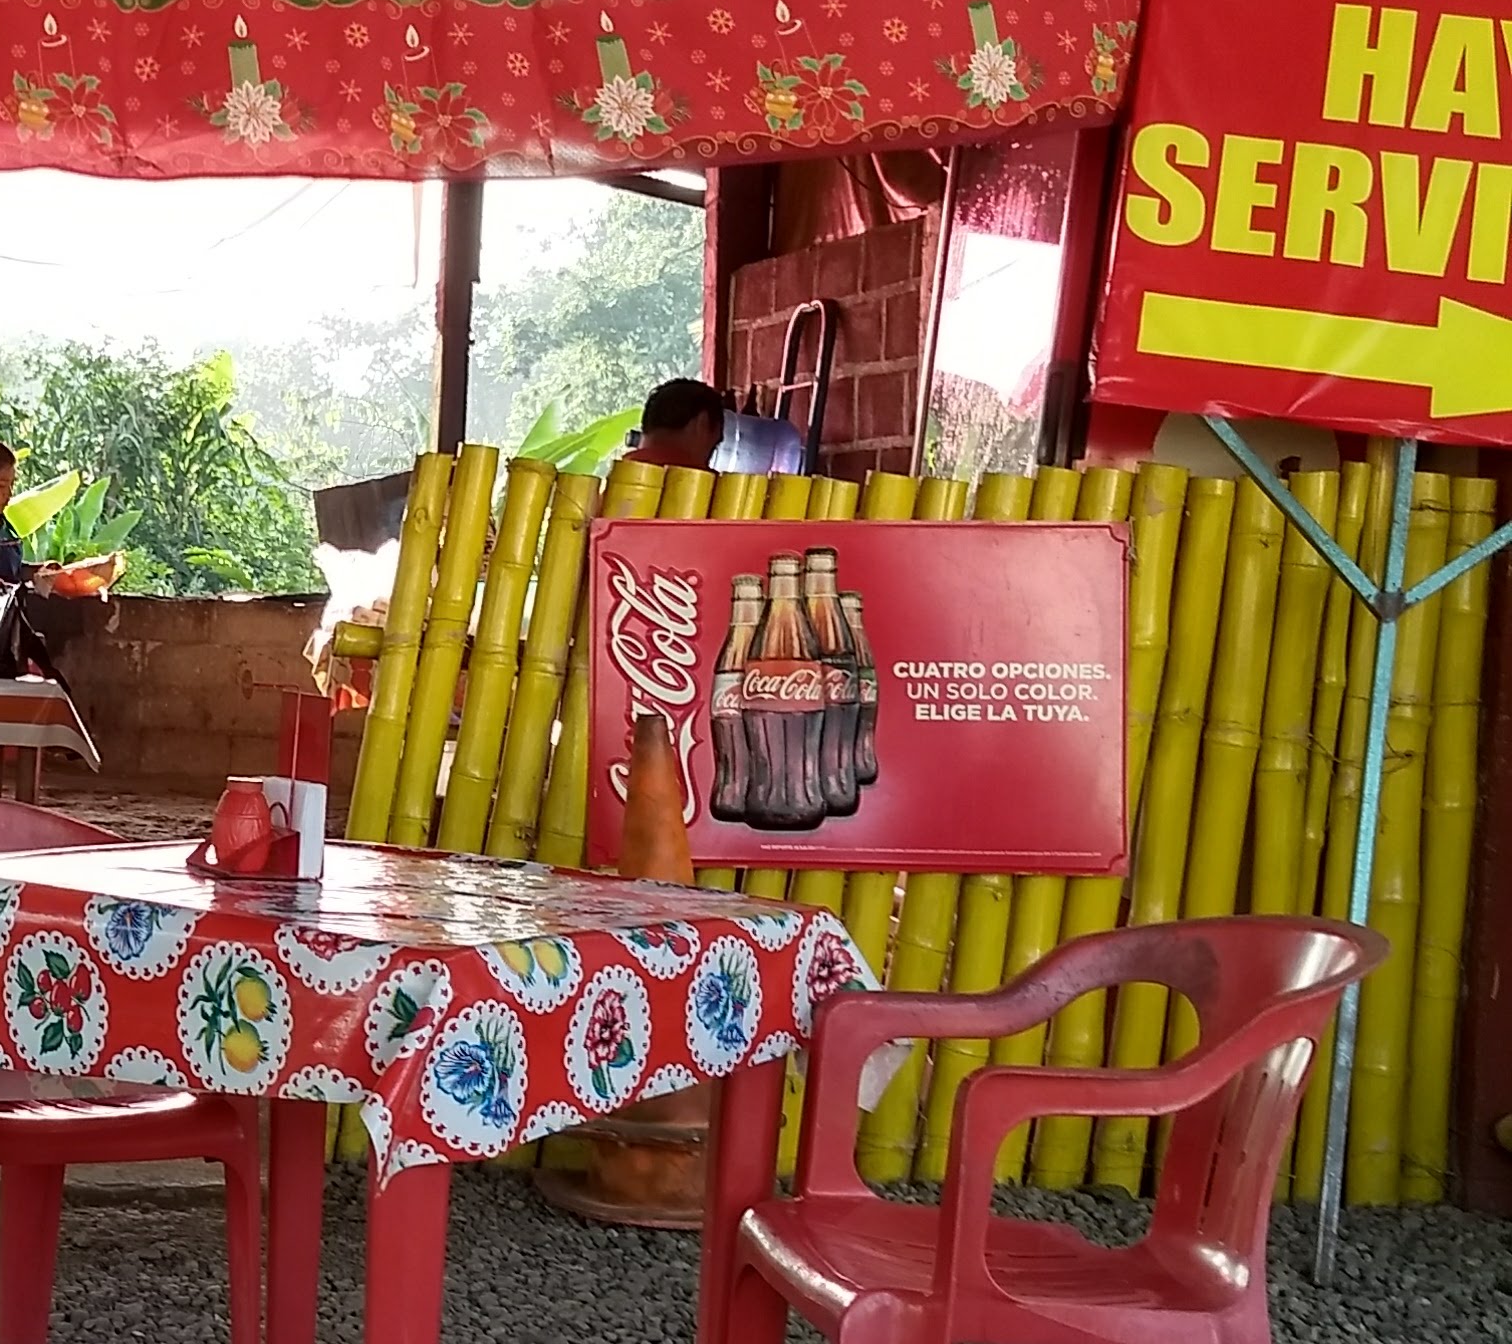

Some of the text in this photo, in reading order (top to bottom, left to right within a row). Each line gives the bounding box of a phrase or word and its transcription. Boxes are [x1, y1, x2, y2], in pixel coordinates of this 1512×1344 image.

[1322, 2, 1512, 139] HA
[1127, 123, 1512, 285] SERVI
[893, 662, 1111, 680] CUATRO OPCIONES.
[906, 683, 1098, 701] UN SOLO COLOR.
[915, 704, 1090, 722] ELIGE LA TUYA.
